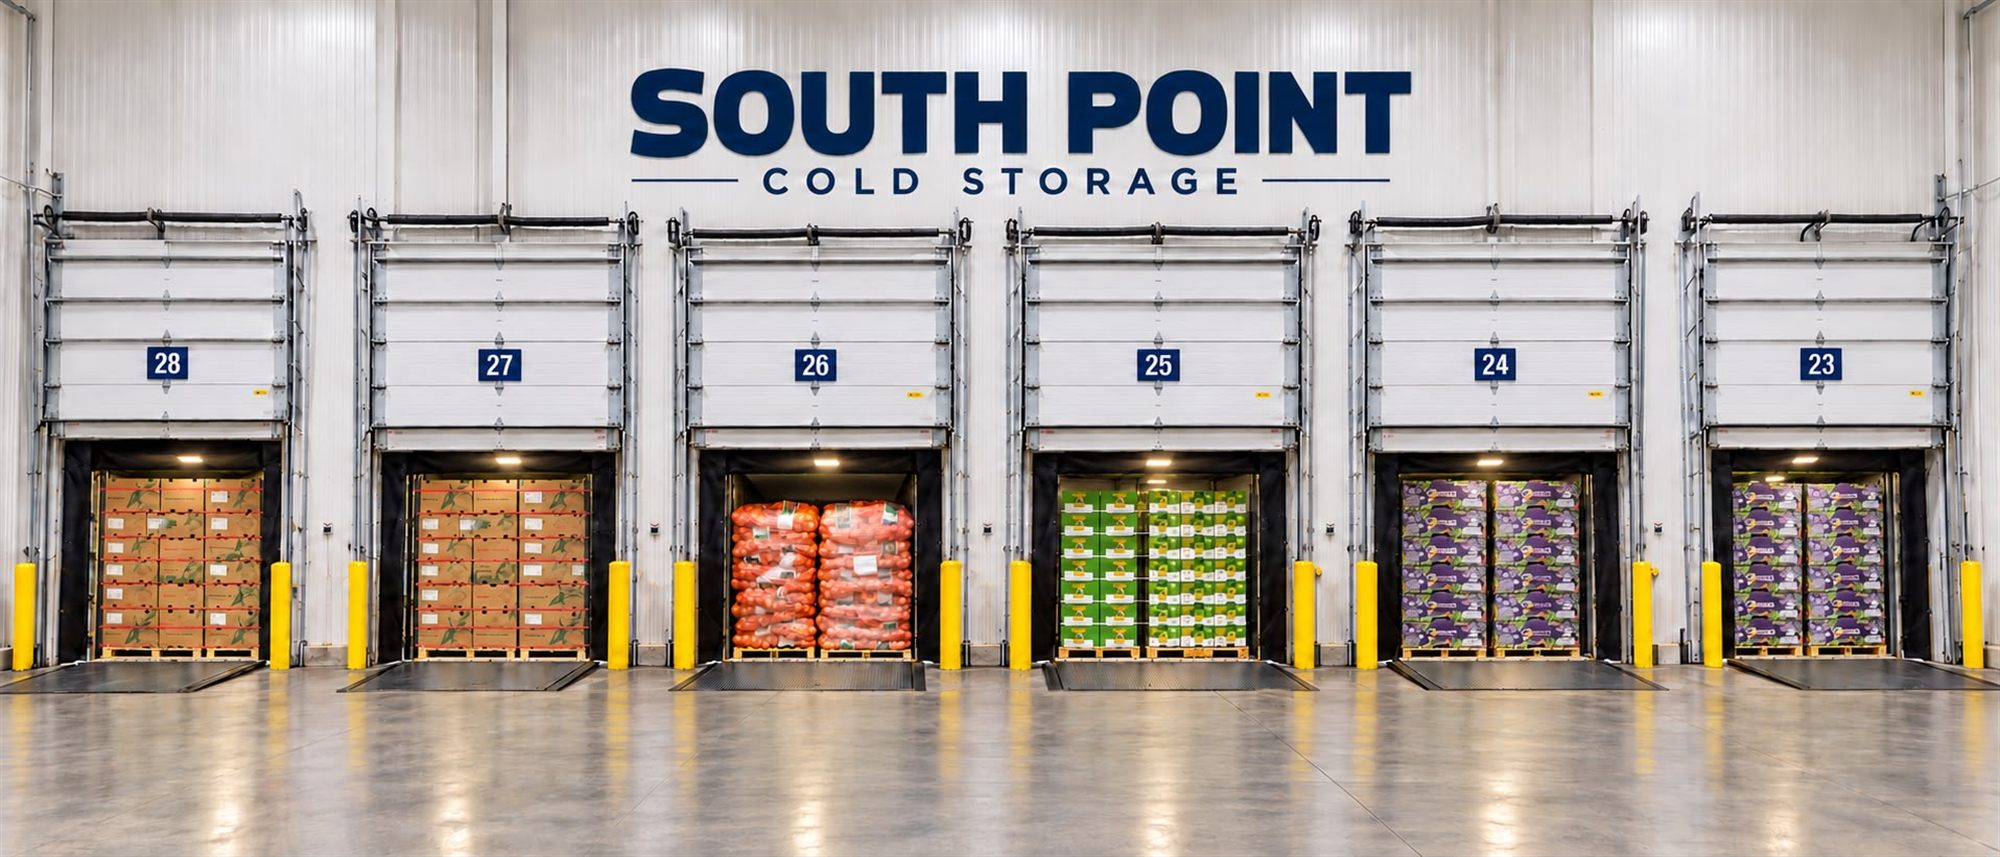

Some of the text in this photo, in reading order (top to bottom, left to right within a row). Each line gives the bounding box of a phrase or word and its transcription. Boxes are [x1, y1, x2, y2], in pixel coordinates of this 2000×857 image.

[631, 69, 1411, 158] SOUTH POINT
[763, 168, 1237, 195] COLD STORAGE
[154, 352, 181, 374] 28
[486, 354, 513, 376] 27
[802, 354, 829, 376] 26
[1145, 354, 1172, 376] 25
[1482, 353, 1509, 375] 24
[1808, 353, 1835, 375] 23
